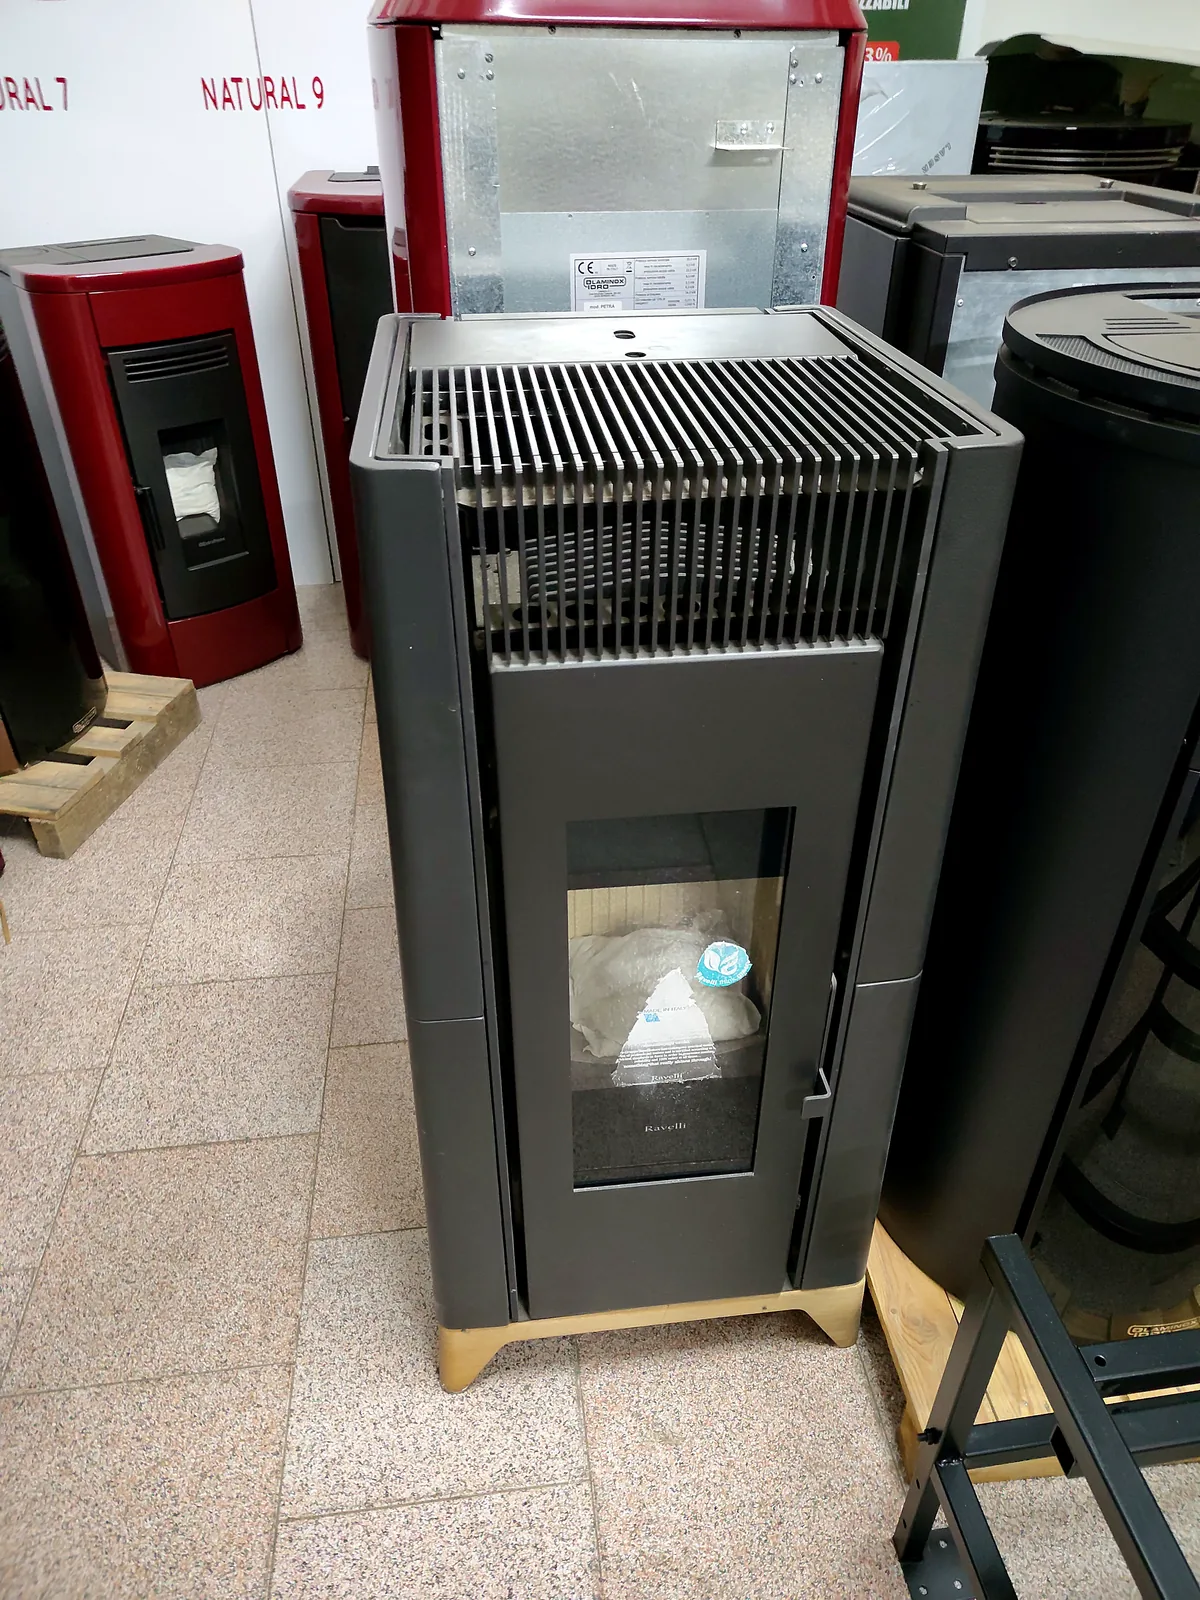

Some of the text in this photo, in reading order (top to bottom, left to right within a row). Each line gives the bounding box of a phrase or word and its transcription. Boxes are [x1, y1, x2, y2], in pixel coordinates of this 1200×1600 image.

[54, 77, 68, 111] 7
[200, 76, 324, 111] NATURAL 9
[651, 1073, 683, 1081] Ravelli
[644, 1122, 687, 1132] Ravelli
